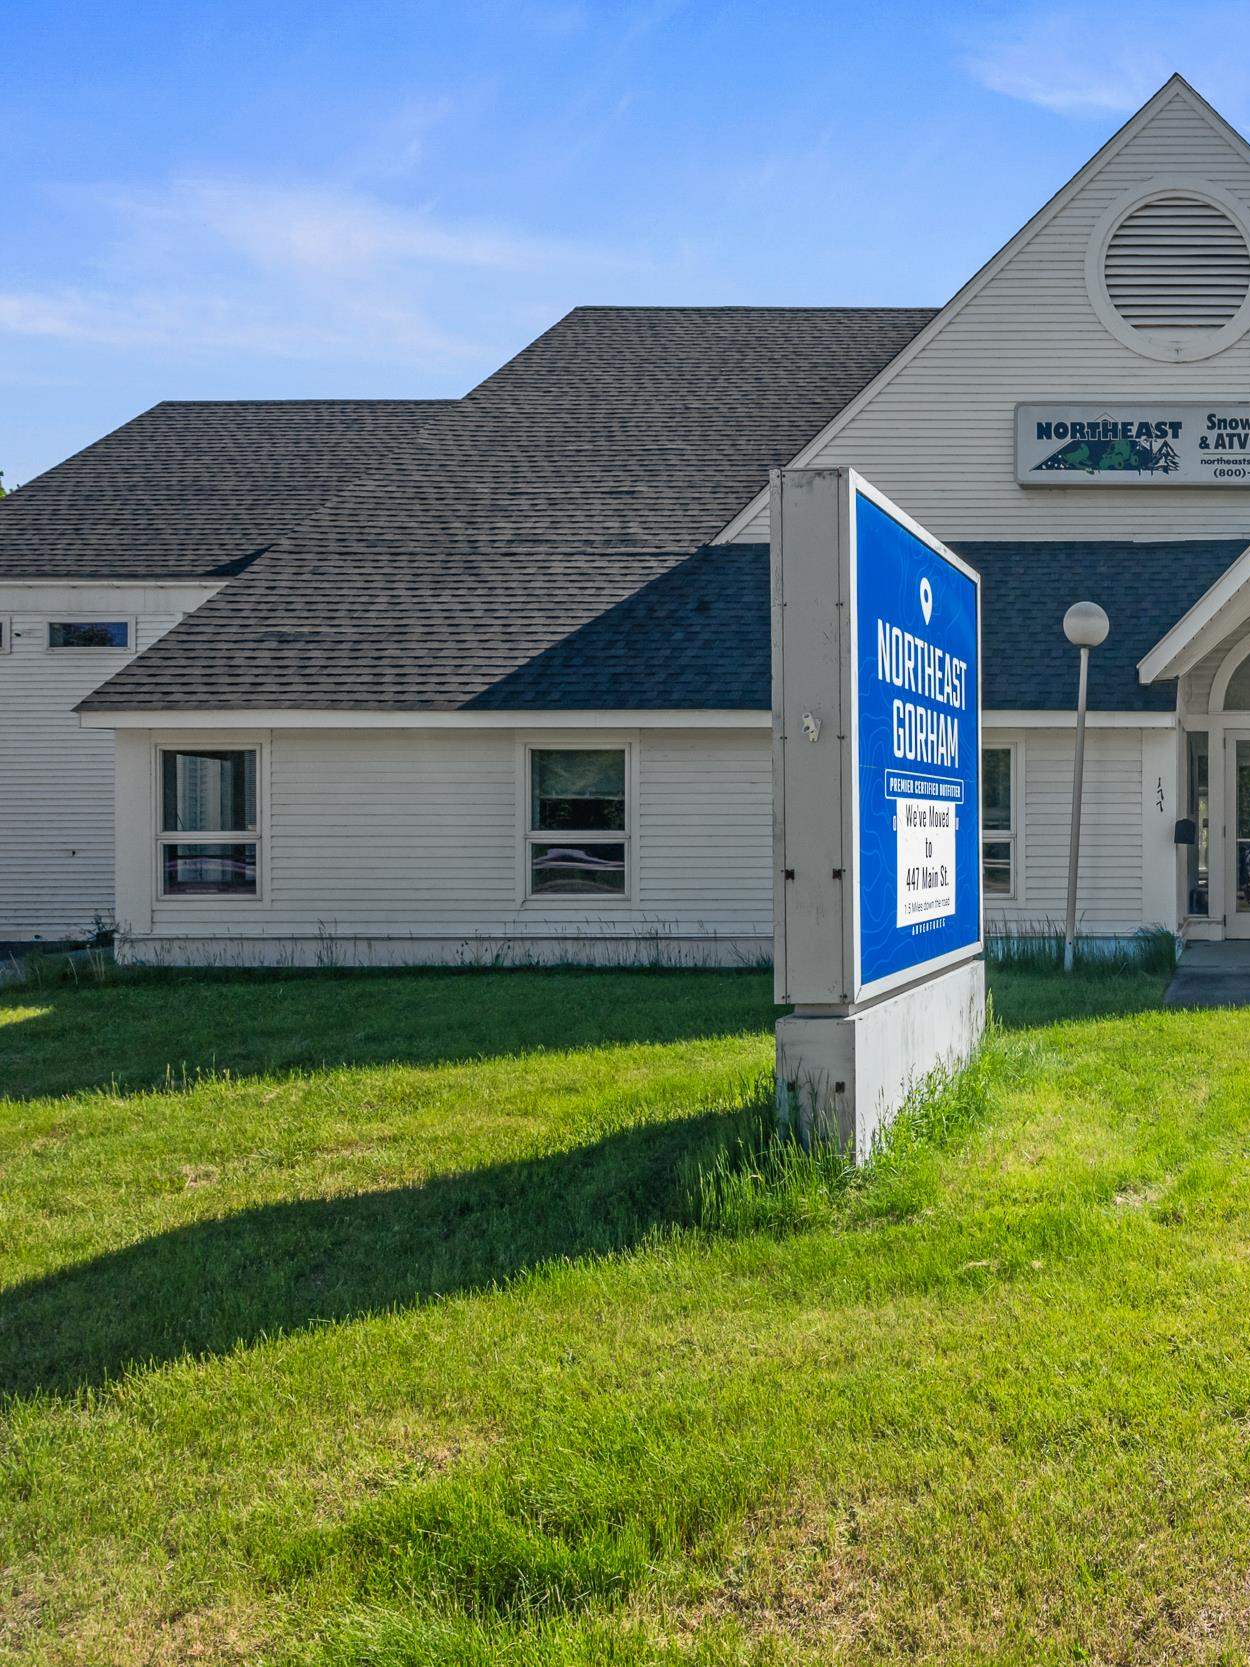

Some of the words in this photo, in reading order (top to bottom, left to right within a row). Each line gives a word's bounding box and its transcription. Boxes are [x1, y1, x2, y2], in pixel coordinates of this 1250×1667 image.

[1036, 421, 1183, 440] NORTHEAST
[1199, 434, 1213, 450] &
[1214, 433, 1249, 450] ATV
[877, 618, 967, 711] NORTHEAST
[892, 698, 959, 769] GORHAM
[890, 777, 914, 793] PREMIER
[914, 781, 939, 796] CERTIFIED
[939, 784, 961, 798] OUTFITTER
[905, 803, 927, 828] We've
[928, 805, 950, 828] Moved
[925, 837, 933, 859] to
[906, 867, 920, 892] 447
[922, 867, 939, 890] Main
[940, 864, 949, 887] St.
